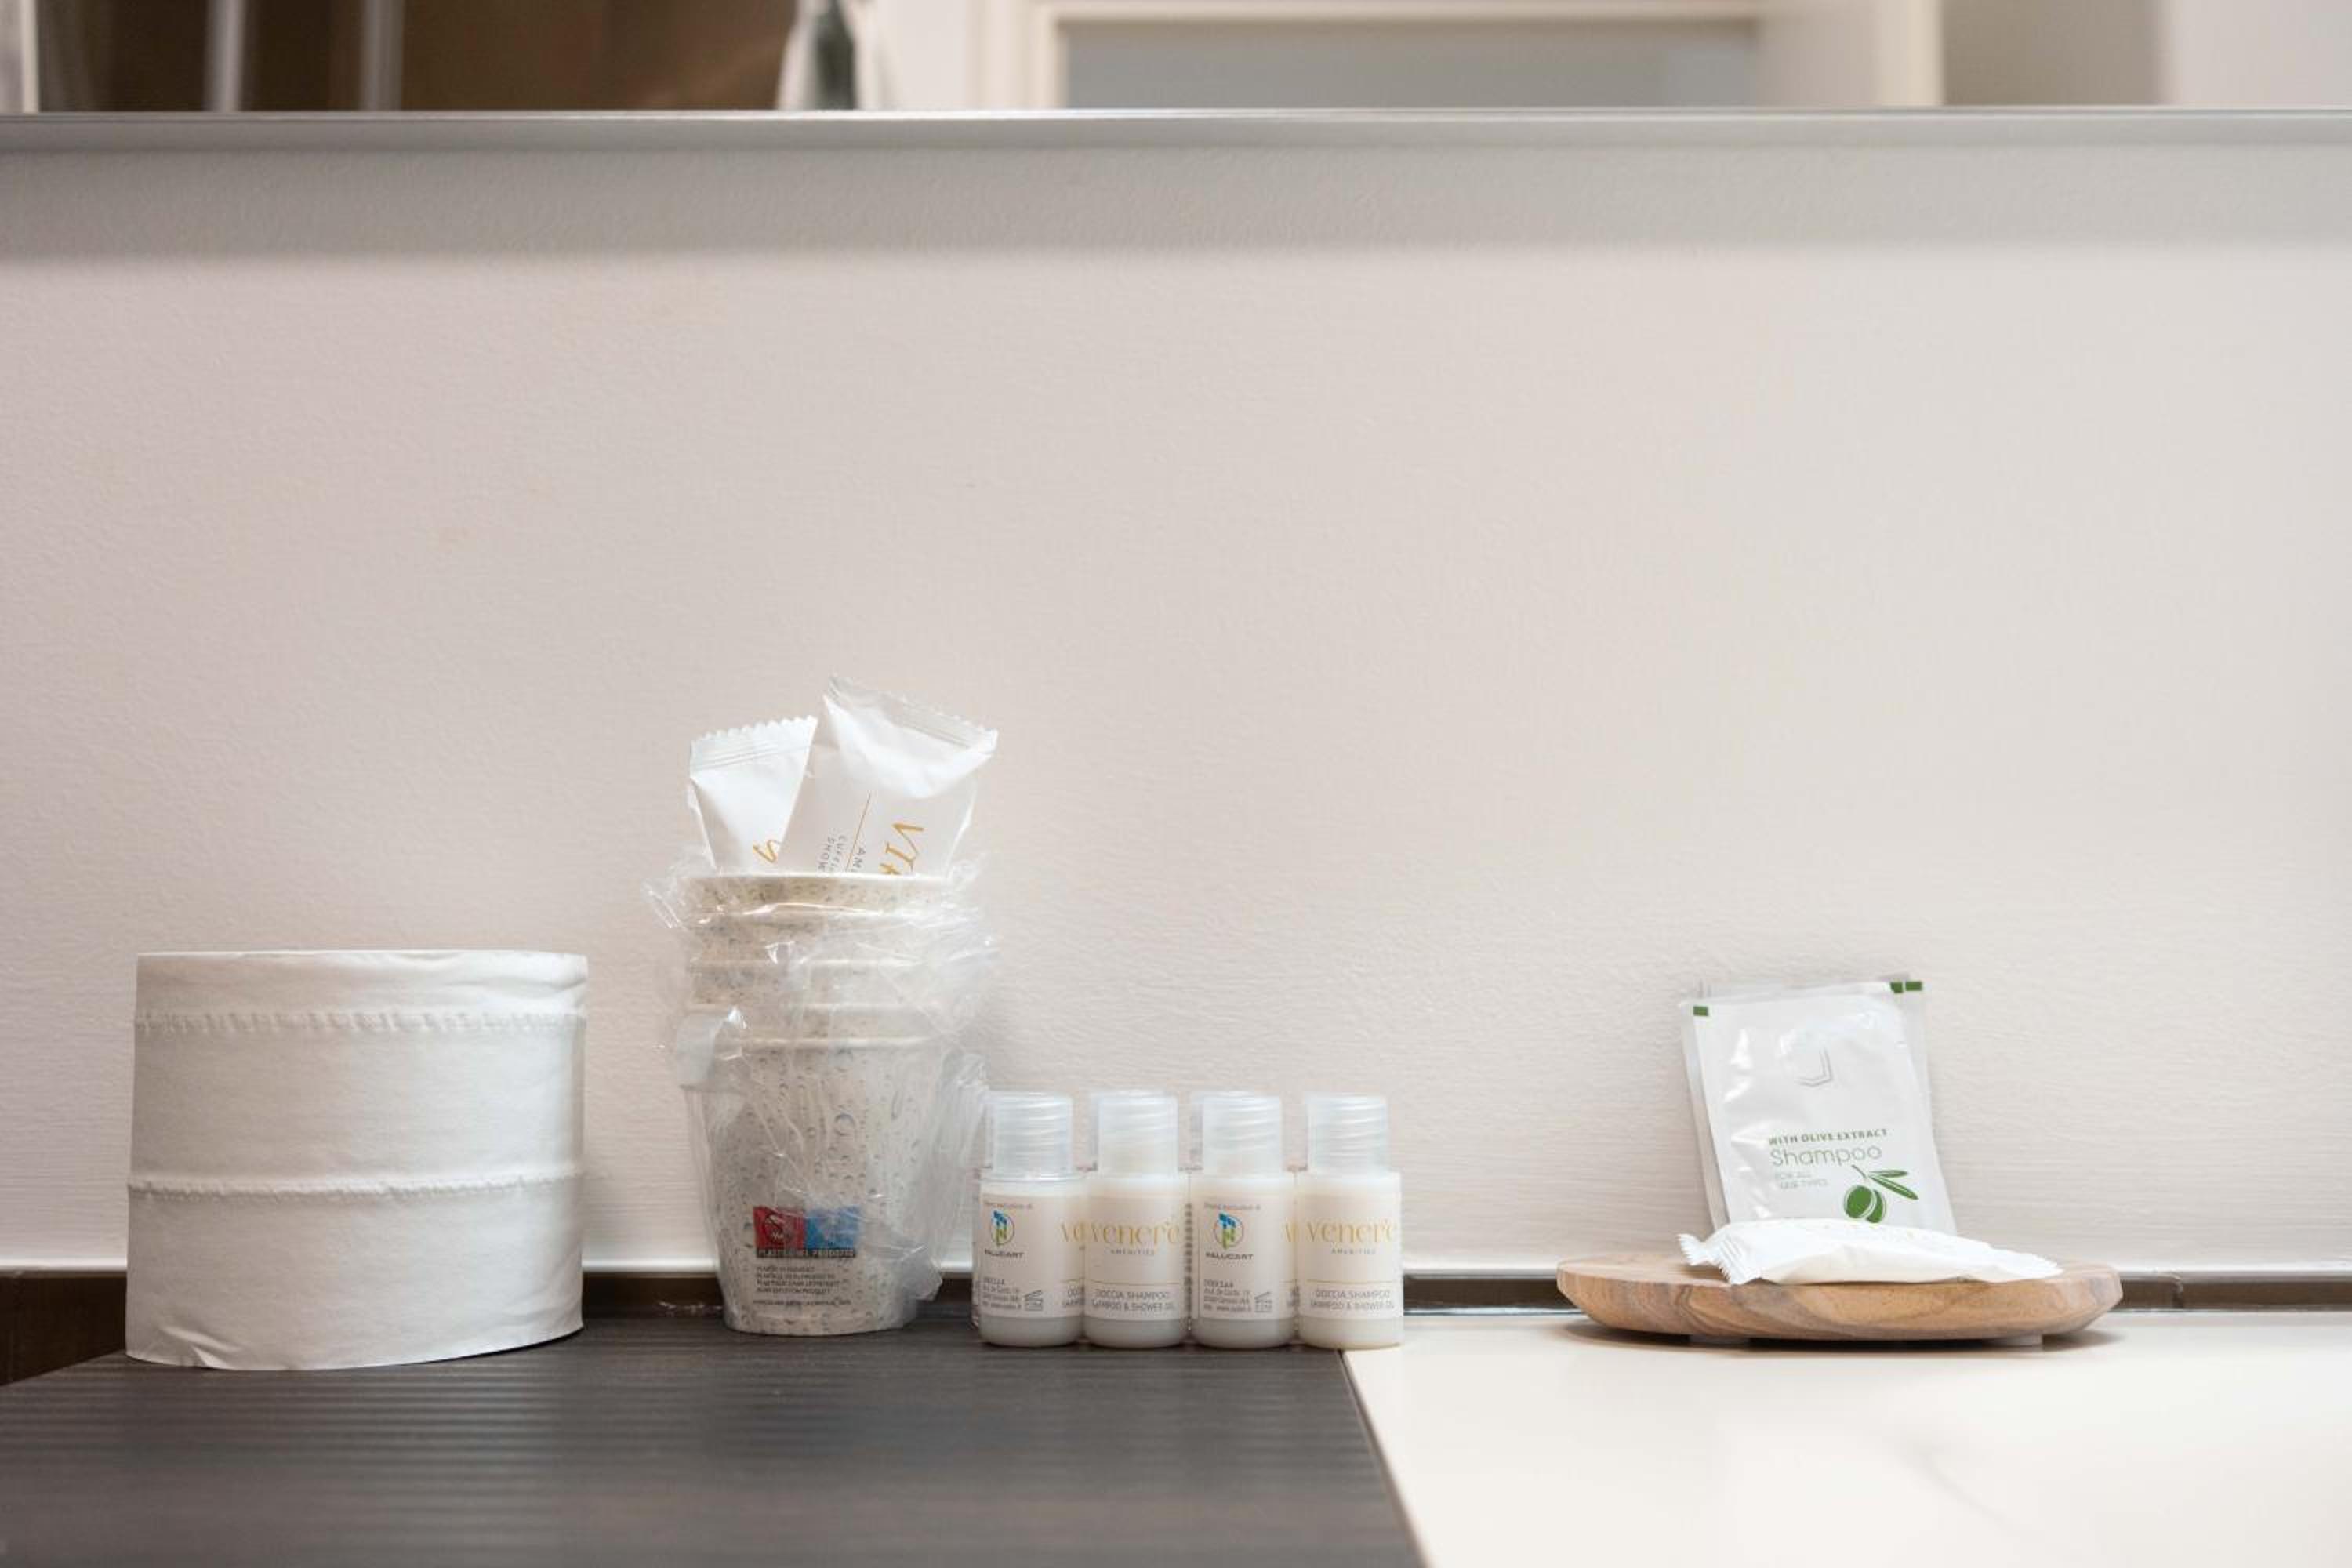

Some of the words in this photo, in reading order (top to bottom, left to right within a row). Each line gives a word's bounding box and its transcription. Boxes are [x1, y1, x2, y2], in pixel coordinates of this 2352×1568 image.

[1769, 1136, 1798, 1145] WITH
[1801, 1132, 1834, 1143] OLIVE
[1837, 1128, 1888, 1141] EXTRACT
[1770, 1145, 1882, 1167] Shampoo
[1127, 1290, 1171, 1300] SHAMPOO
